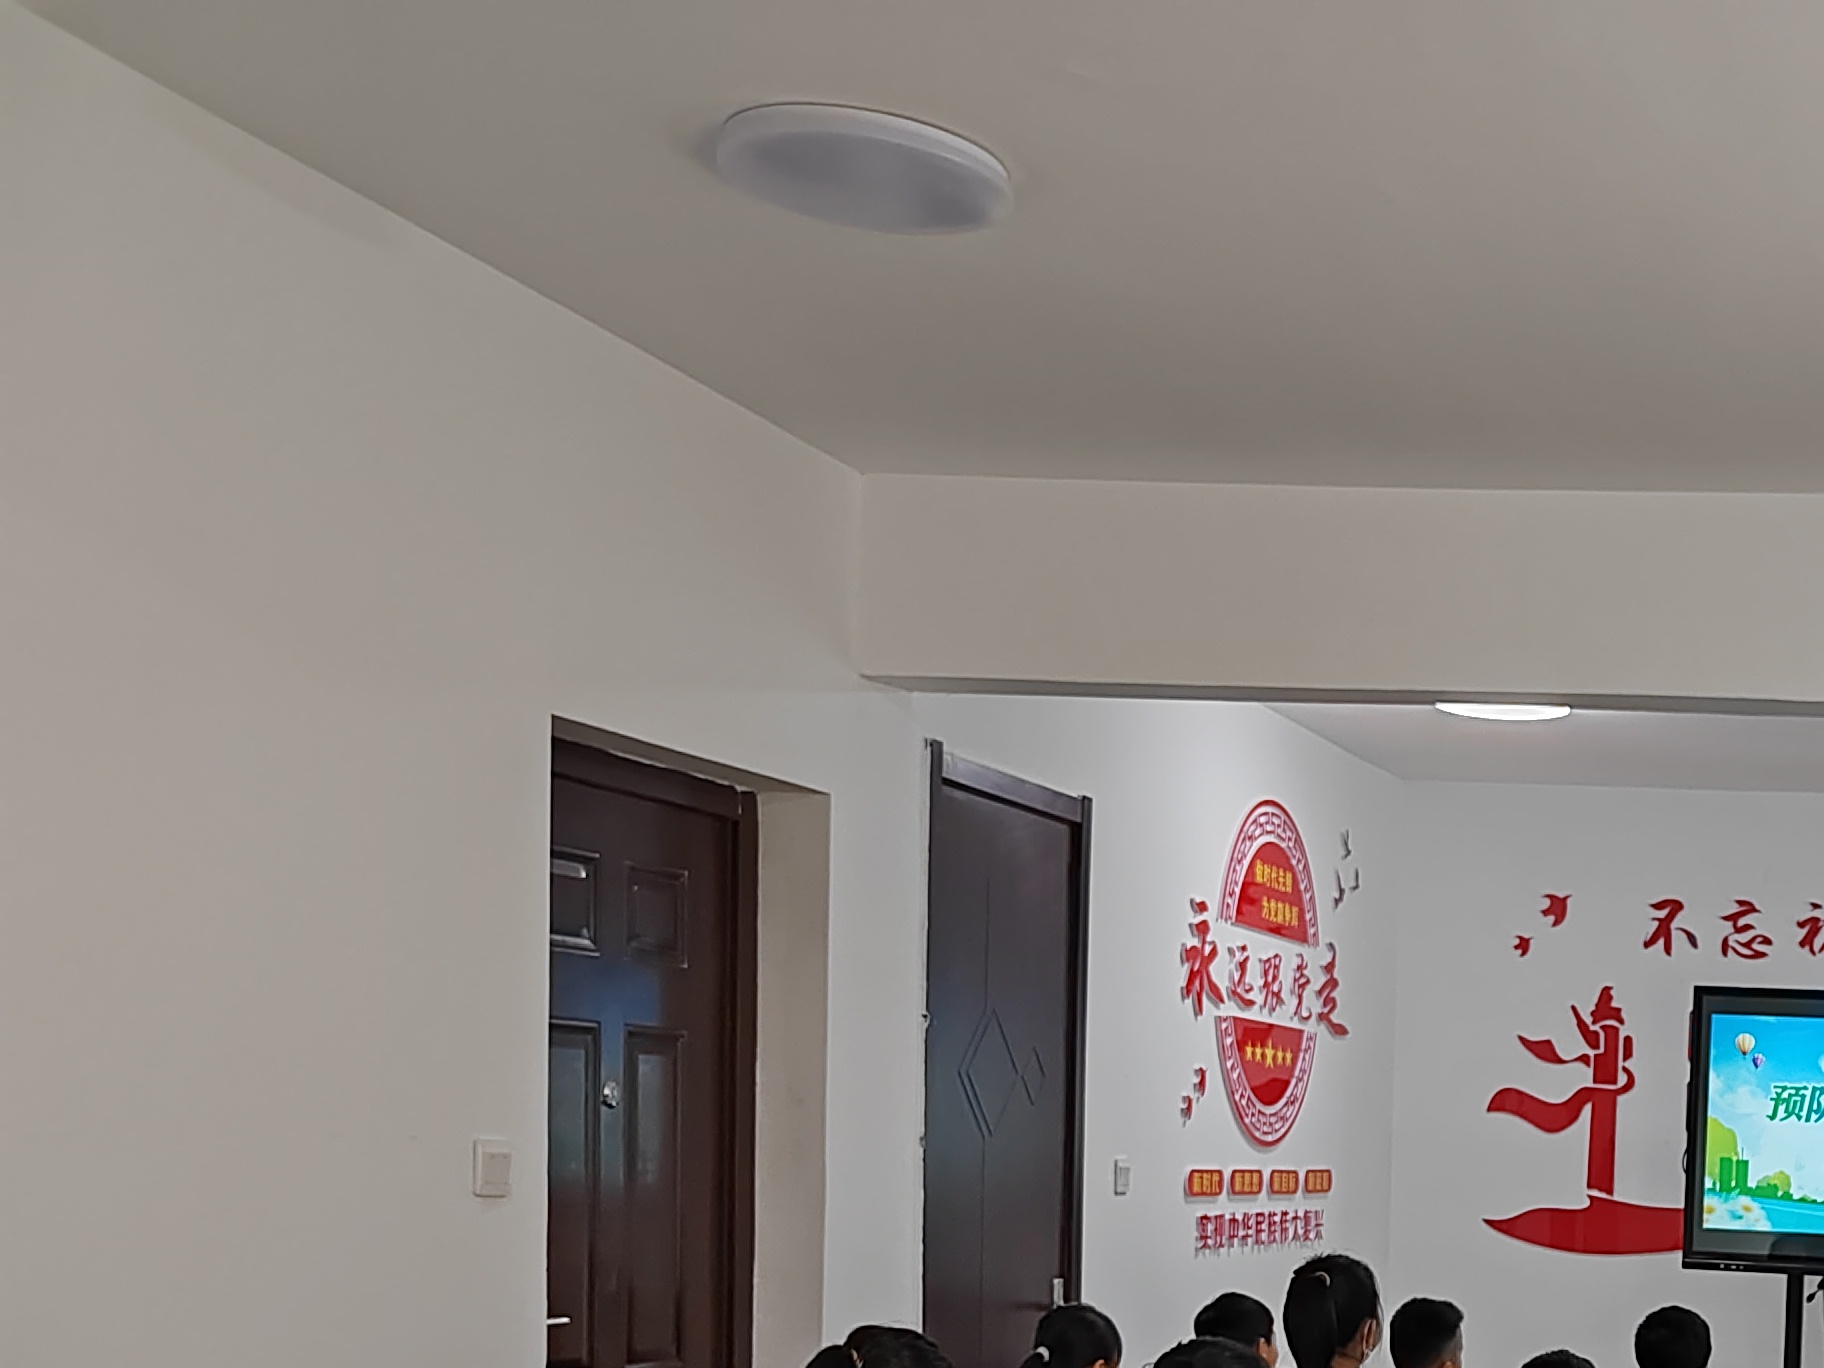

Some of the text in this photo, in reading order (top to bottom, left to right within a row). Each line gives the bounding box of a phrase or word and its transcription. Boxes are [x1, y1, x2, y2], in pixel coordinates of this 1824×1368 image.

[1183, 898, 1349, 1036] 永远跟党走
[1198, 1209, 1325, 1250] 实现中华民族伟大复兴
